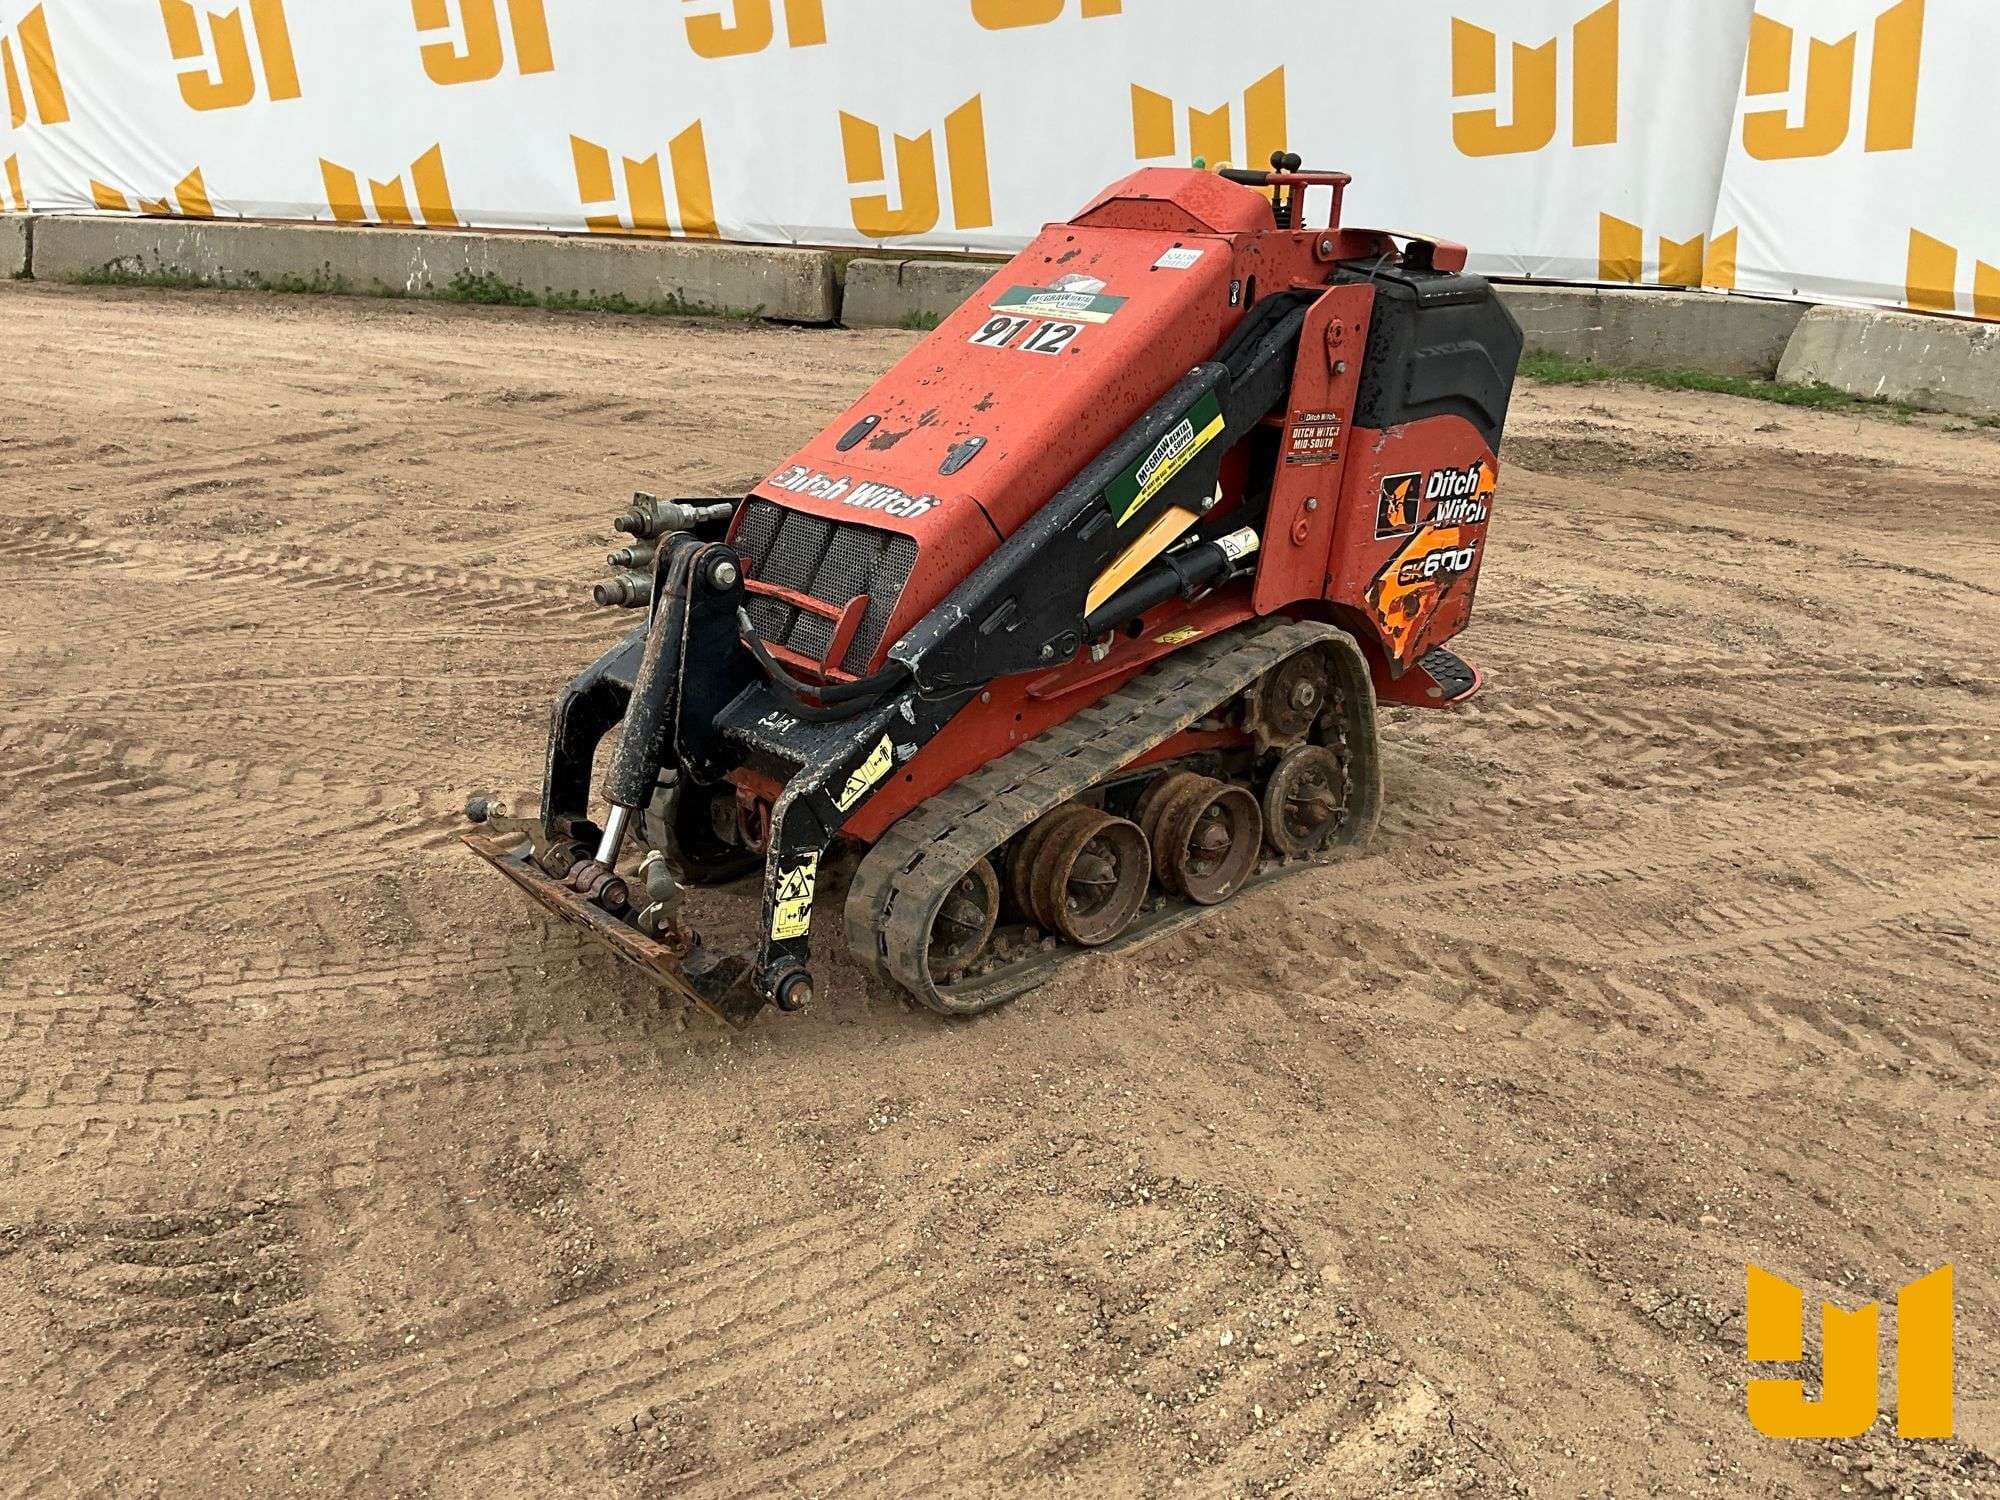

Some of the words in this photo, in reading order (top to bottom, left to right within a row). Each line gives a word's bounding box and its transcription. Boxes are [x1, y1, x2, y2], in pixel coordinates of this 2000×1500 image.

[1169, 421, 1191, 446] RENTAL
[1173, 431, 1193, 452] SUPPLY
[1292, 427, 1314, 439] DITCH
[1425, 467, 1480, 499] Ditch
[843, 480, 934, 519] Witch
[1435, 496, 1487, 526] Witch
